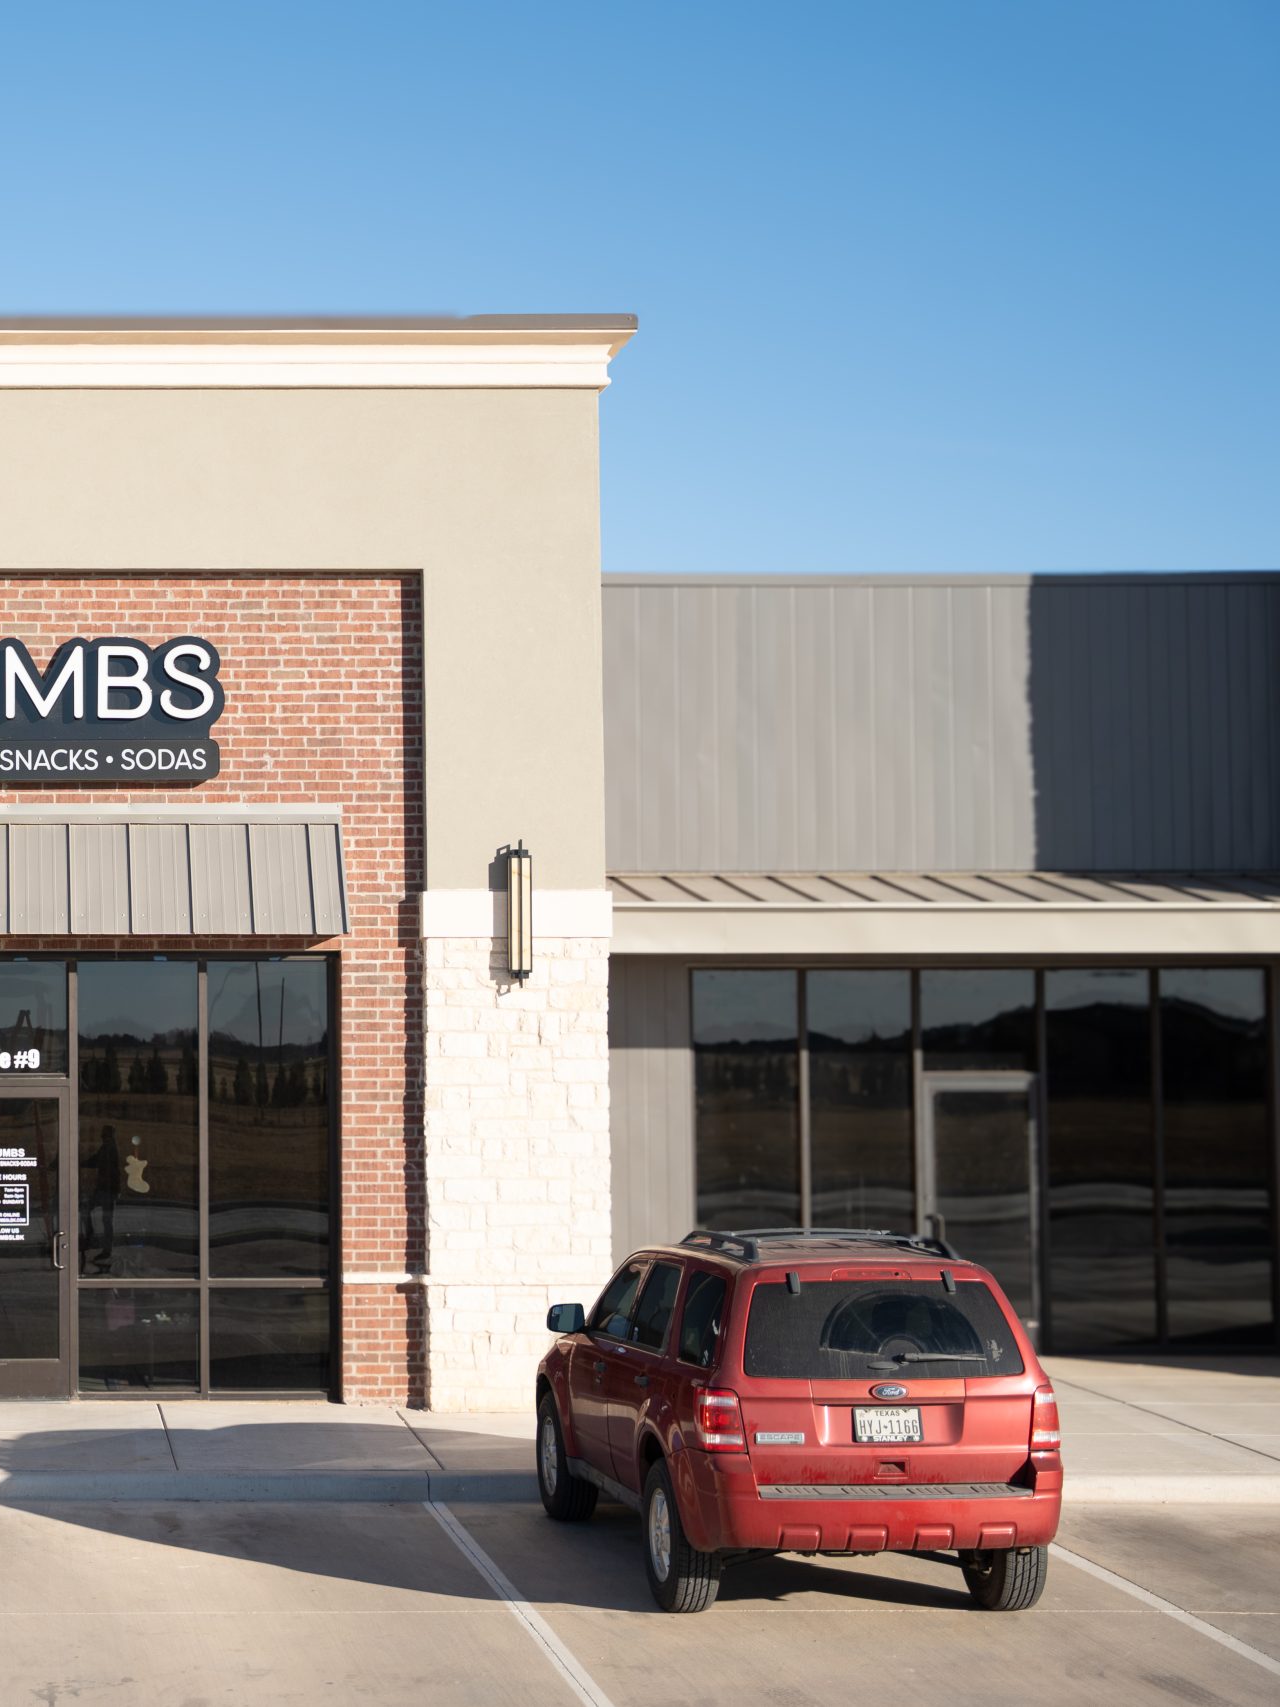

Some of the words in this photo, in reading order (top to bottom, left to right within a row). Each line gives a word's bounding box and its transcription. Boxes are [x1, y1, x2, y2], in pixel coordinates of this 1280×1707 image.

[120, 748, 208, 771] SODAS
[13, 1048, 40, 1069] #9
[2, 1173, 27, 1181] HOURS
[881, 1386, 901, 1397] Ford
